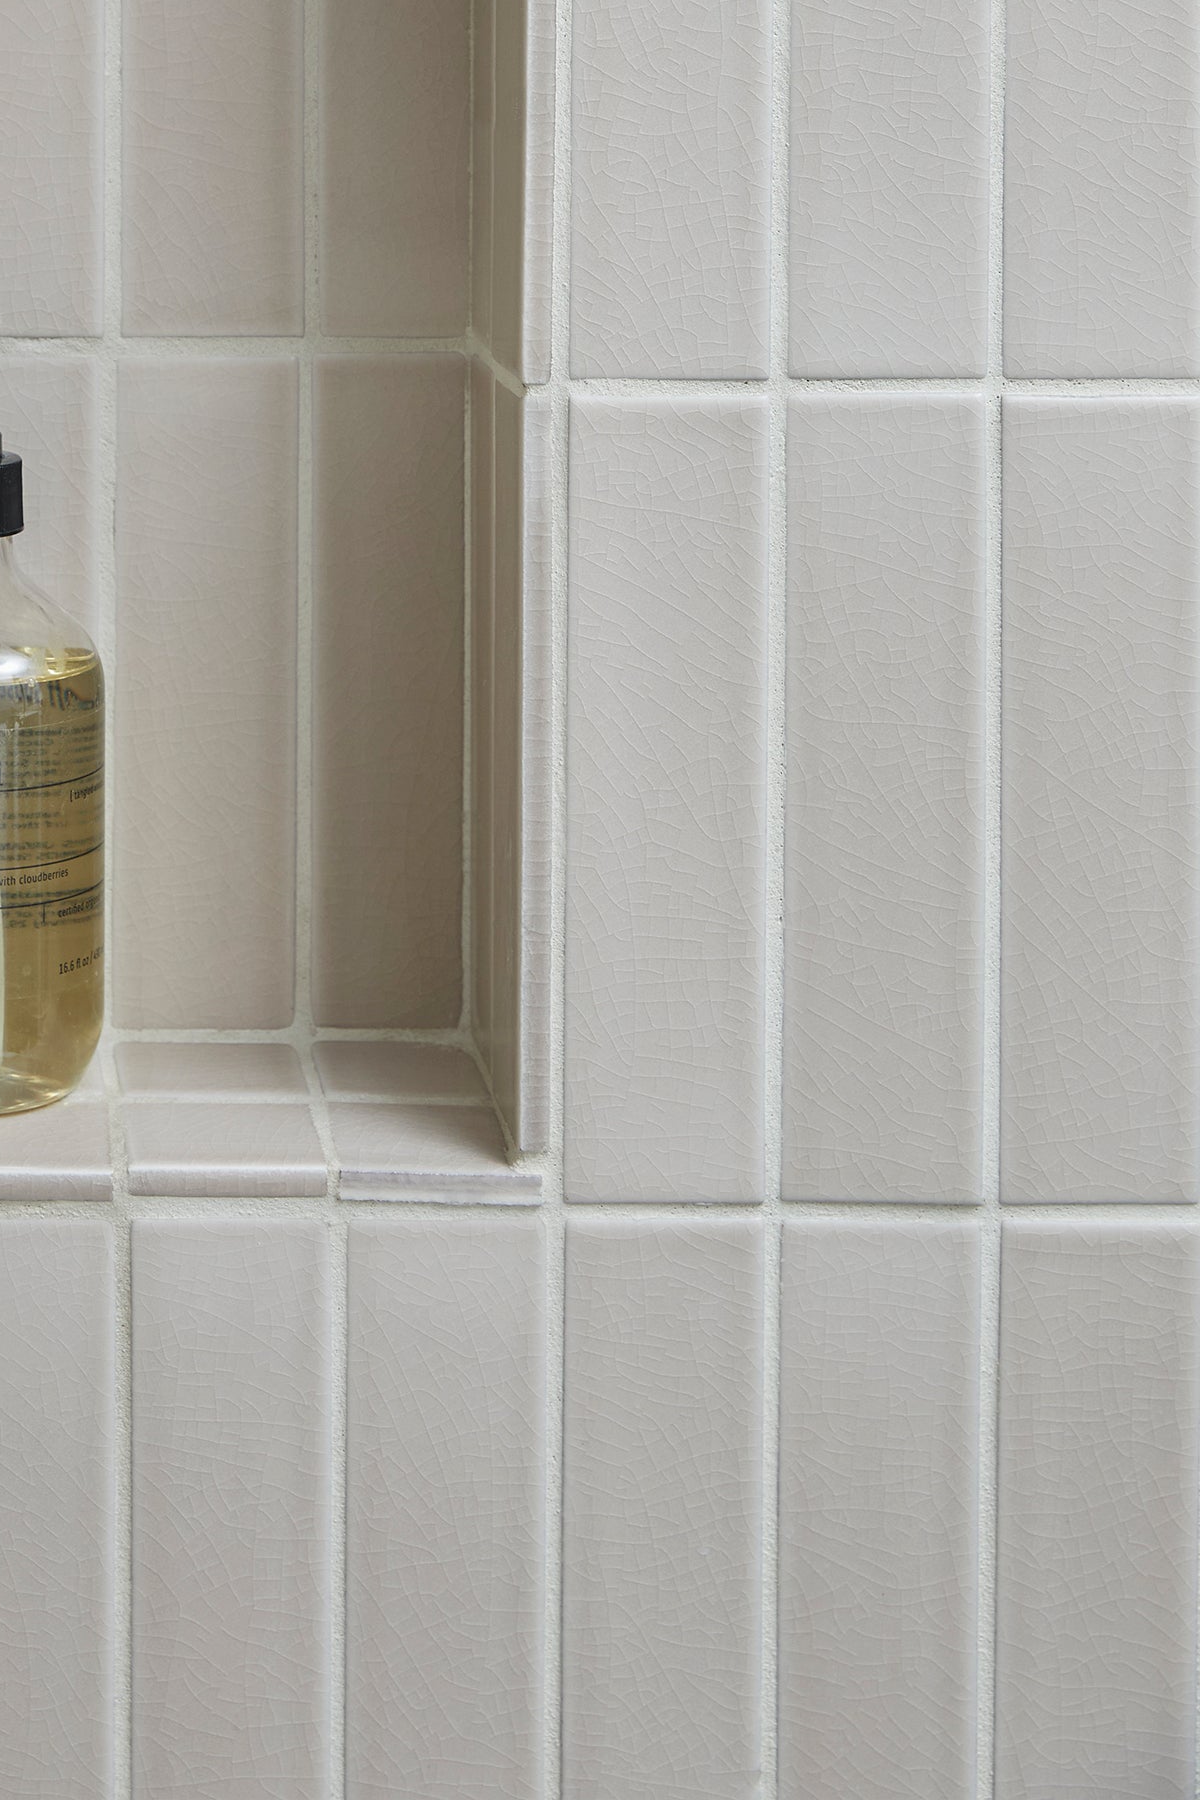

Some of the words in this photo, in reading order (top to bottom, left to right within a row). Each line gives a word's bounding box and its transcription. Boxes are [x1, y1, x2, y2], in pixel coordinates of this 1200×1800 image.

[19, 868, 69, 885] cloudberries
[57, 901, 85, 918] certified
[59, 960, 75, 975] 16.6
